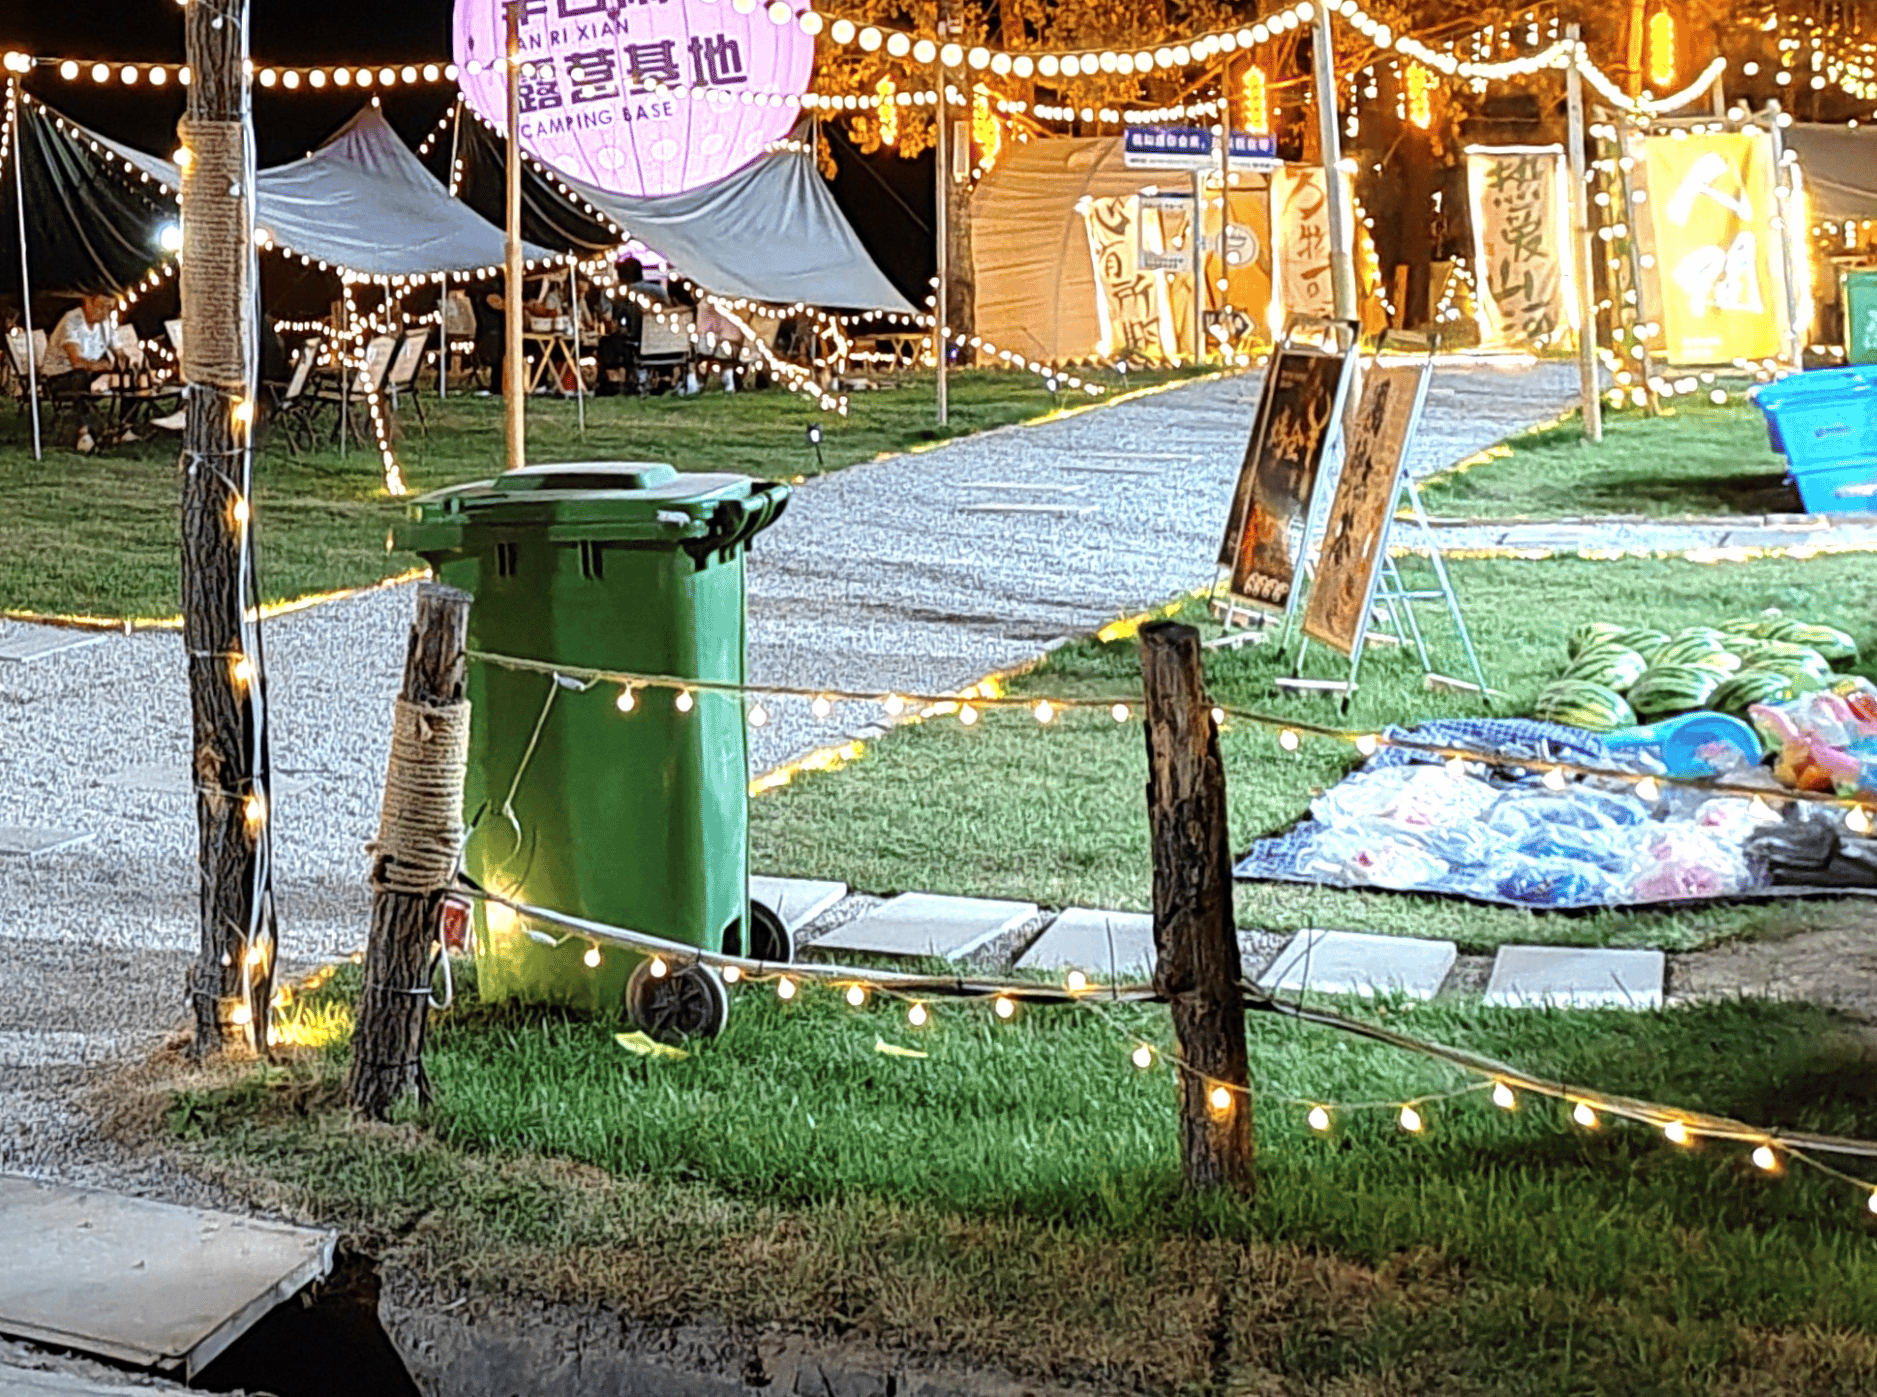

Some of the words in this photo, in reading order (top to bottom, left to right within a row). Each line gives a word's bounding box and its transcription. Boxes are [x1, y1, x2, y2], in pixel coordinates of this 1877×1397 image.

[515, 33, 542, 51] AN
[550, 28, 568, 47] RI
[578, 19, 630, 41] XIAN
[518, 33, 748, 114] 露营基地
[521, 109, 613, 139] CAMPING
[622, 101, 673, 122] BASE
[1282, 171, 1333, 312] 万物可
